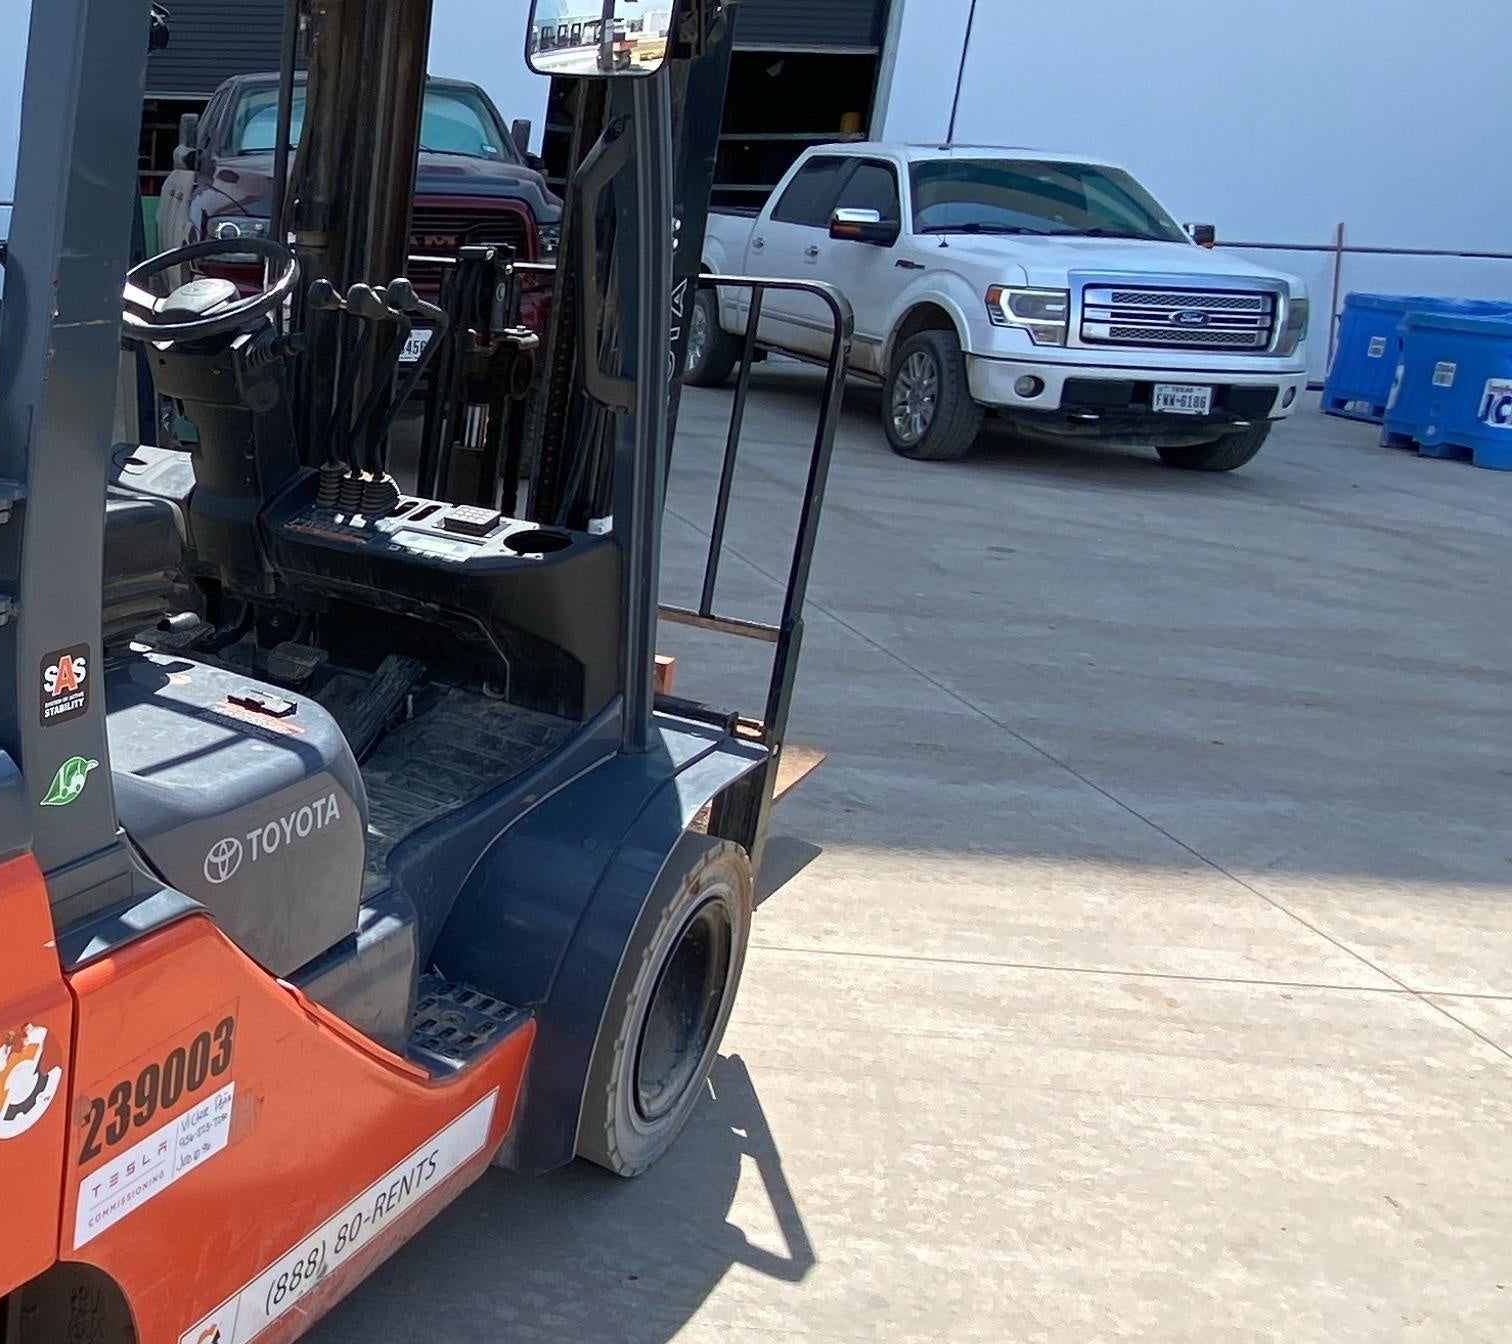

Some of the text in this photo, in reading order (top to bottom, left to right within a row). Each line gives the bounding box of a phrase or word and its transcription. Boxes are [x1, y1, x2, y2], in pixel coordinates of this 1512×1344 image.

[43, 654, 87, 697] SAS
[44, 697, 85, 718] STABILITY
[246, 793, 341, 862] TOYOTA
[78, 1016, 235, 1167] 239003
[91, 1139, 168, 1198] TESLA
[87, 1169, 165, 1228] COMMISSIONING
[266, 1148, 440, 1316] (888) 80-RENTS
